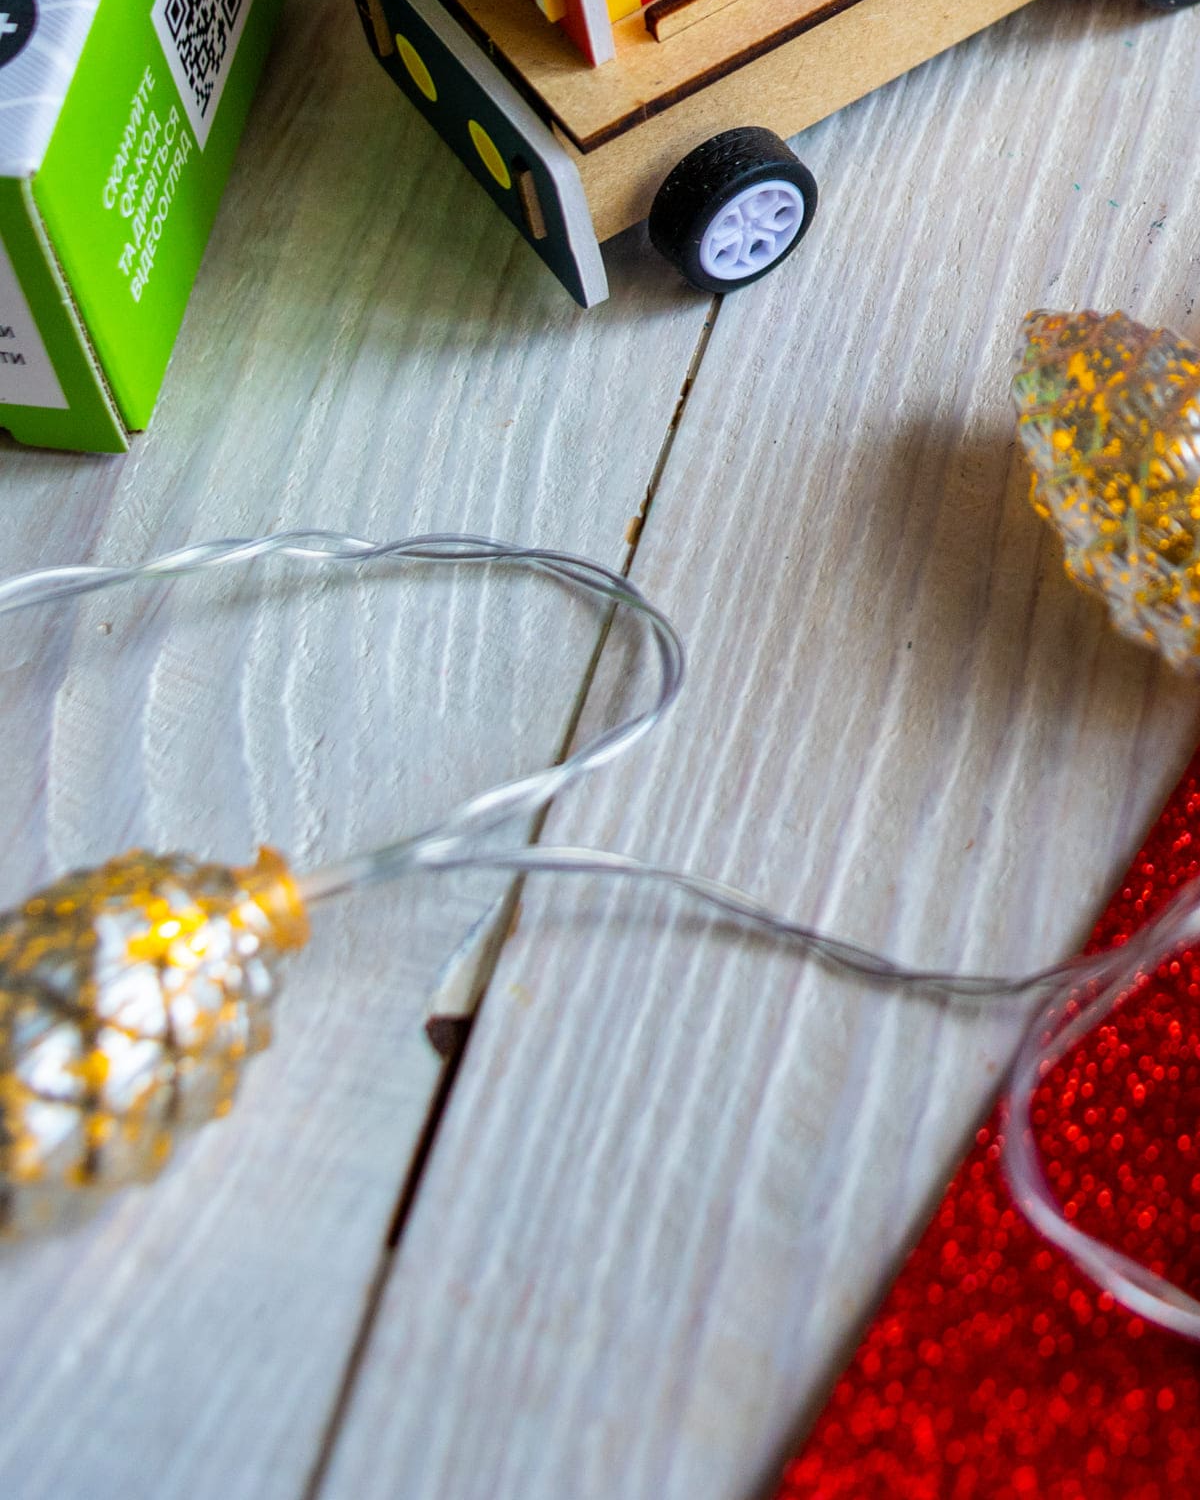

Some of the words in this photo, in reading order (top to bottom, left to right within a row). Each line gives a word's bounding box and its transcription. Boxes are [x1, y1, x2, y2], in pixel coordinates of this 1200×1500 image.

[103, 65, 156, 210] СКАНУЙТЕ
[118, 242, 137, 276] ТА
[132, 105, 180, 249] ДИВІТЬСЯ
[119, 110, 161, 218] QR-КОД
[130, 128, 193, 303] ВІДЕООГЛЯД
